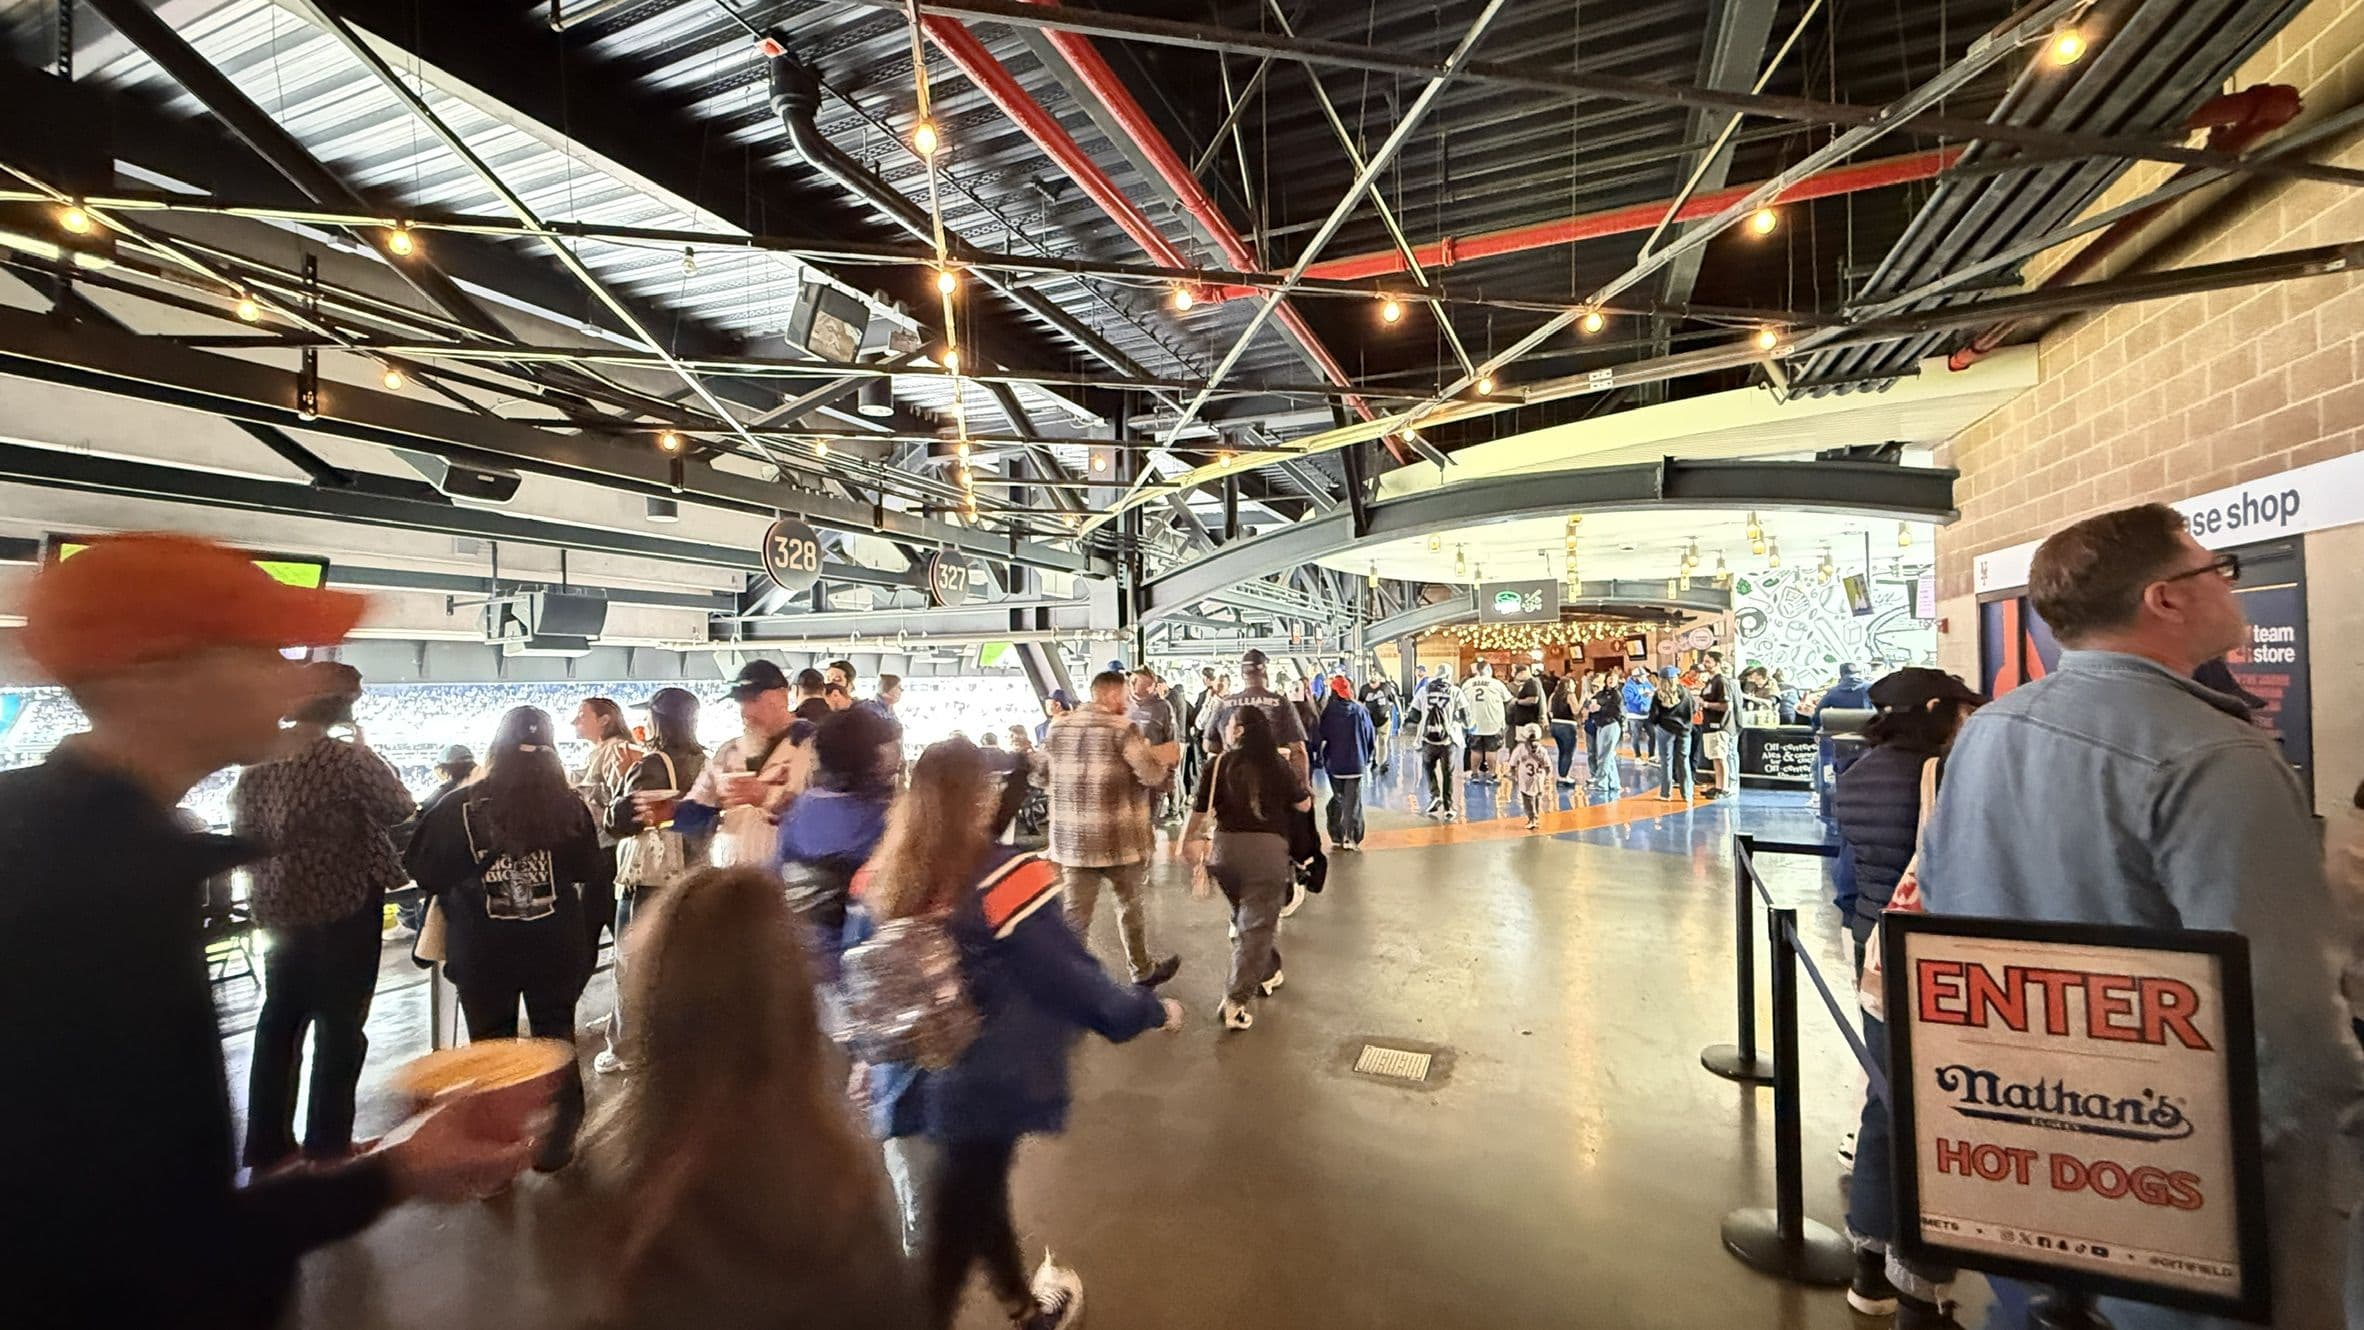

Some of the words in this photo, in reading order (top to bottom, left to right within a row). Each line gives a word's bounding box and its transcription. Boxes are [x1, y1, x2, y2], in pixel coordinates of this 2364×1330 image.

[2226, 489, 2300, 528] shop
[773, 535, 818, 573] 328
[938, 563, 967, 592] 327
[2252, 624, 2295, 643] team
[2252, 644, 2296, 663] store
[1475, 688, 1485, 702] 2
[1782, 751, 1795, 762] &
[1916, 958, 2216, 1052] ENTER
[1935, 1064, 2186, 1129] Nathan's
[1936, 1137, 2039, 1186] HOT
[2050, 1152, 2205, 1210] DOGS
